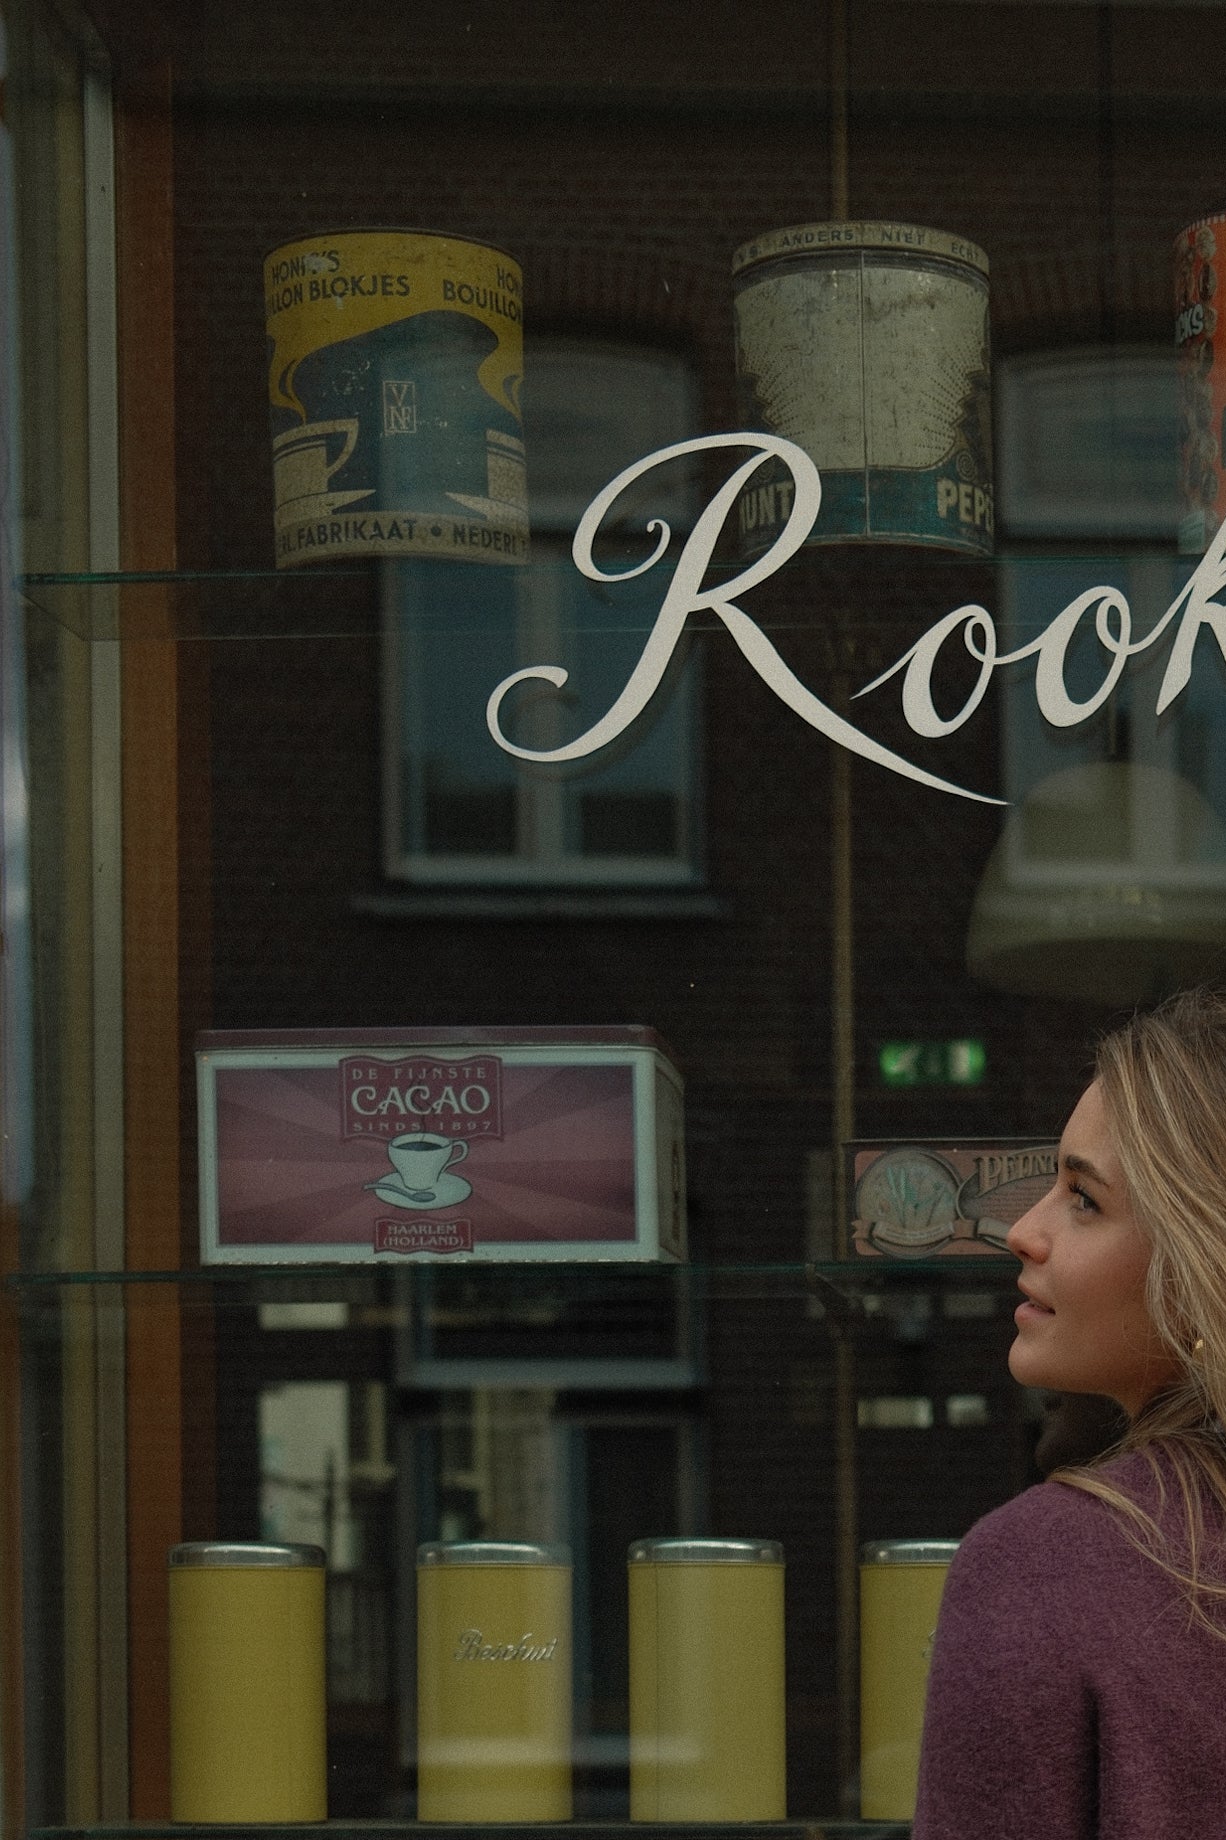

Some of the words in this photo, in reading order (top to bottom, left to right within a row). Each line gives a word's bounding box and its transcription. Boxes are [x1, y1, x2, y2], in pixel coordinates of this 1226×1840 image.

[782, 229, 854, 248] ANDERS
[881, 229, 925, 246] NIET
[308, 274, 411, 302] BLOKJES
[297, 519, 417, 550] FABRIKAAT
[352, 1068, 378, 1080] DE
[394, 1067, 486, 1080] FIJNSTE
[351, 1085, 491, 1116] CACAO
[353, 1121, 421, 1132] SINDS
[439, 1121, 492, 1132] 1897
[387, 1225, 458, 1235] HAARLEM
[383, 1236, 464, 1247] (HOLLAND)
[454, 1628, 559, 1662] Beschuit
